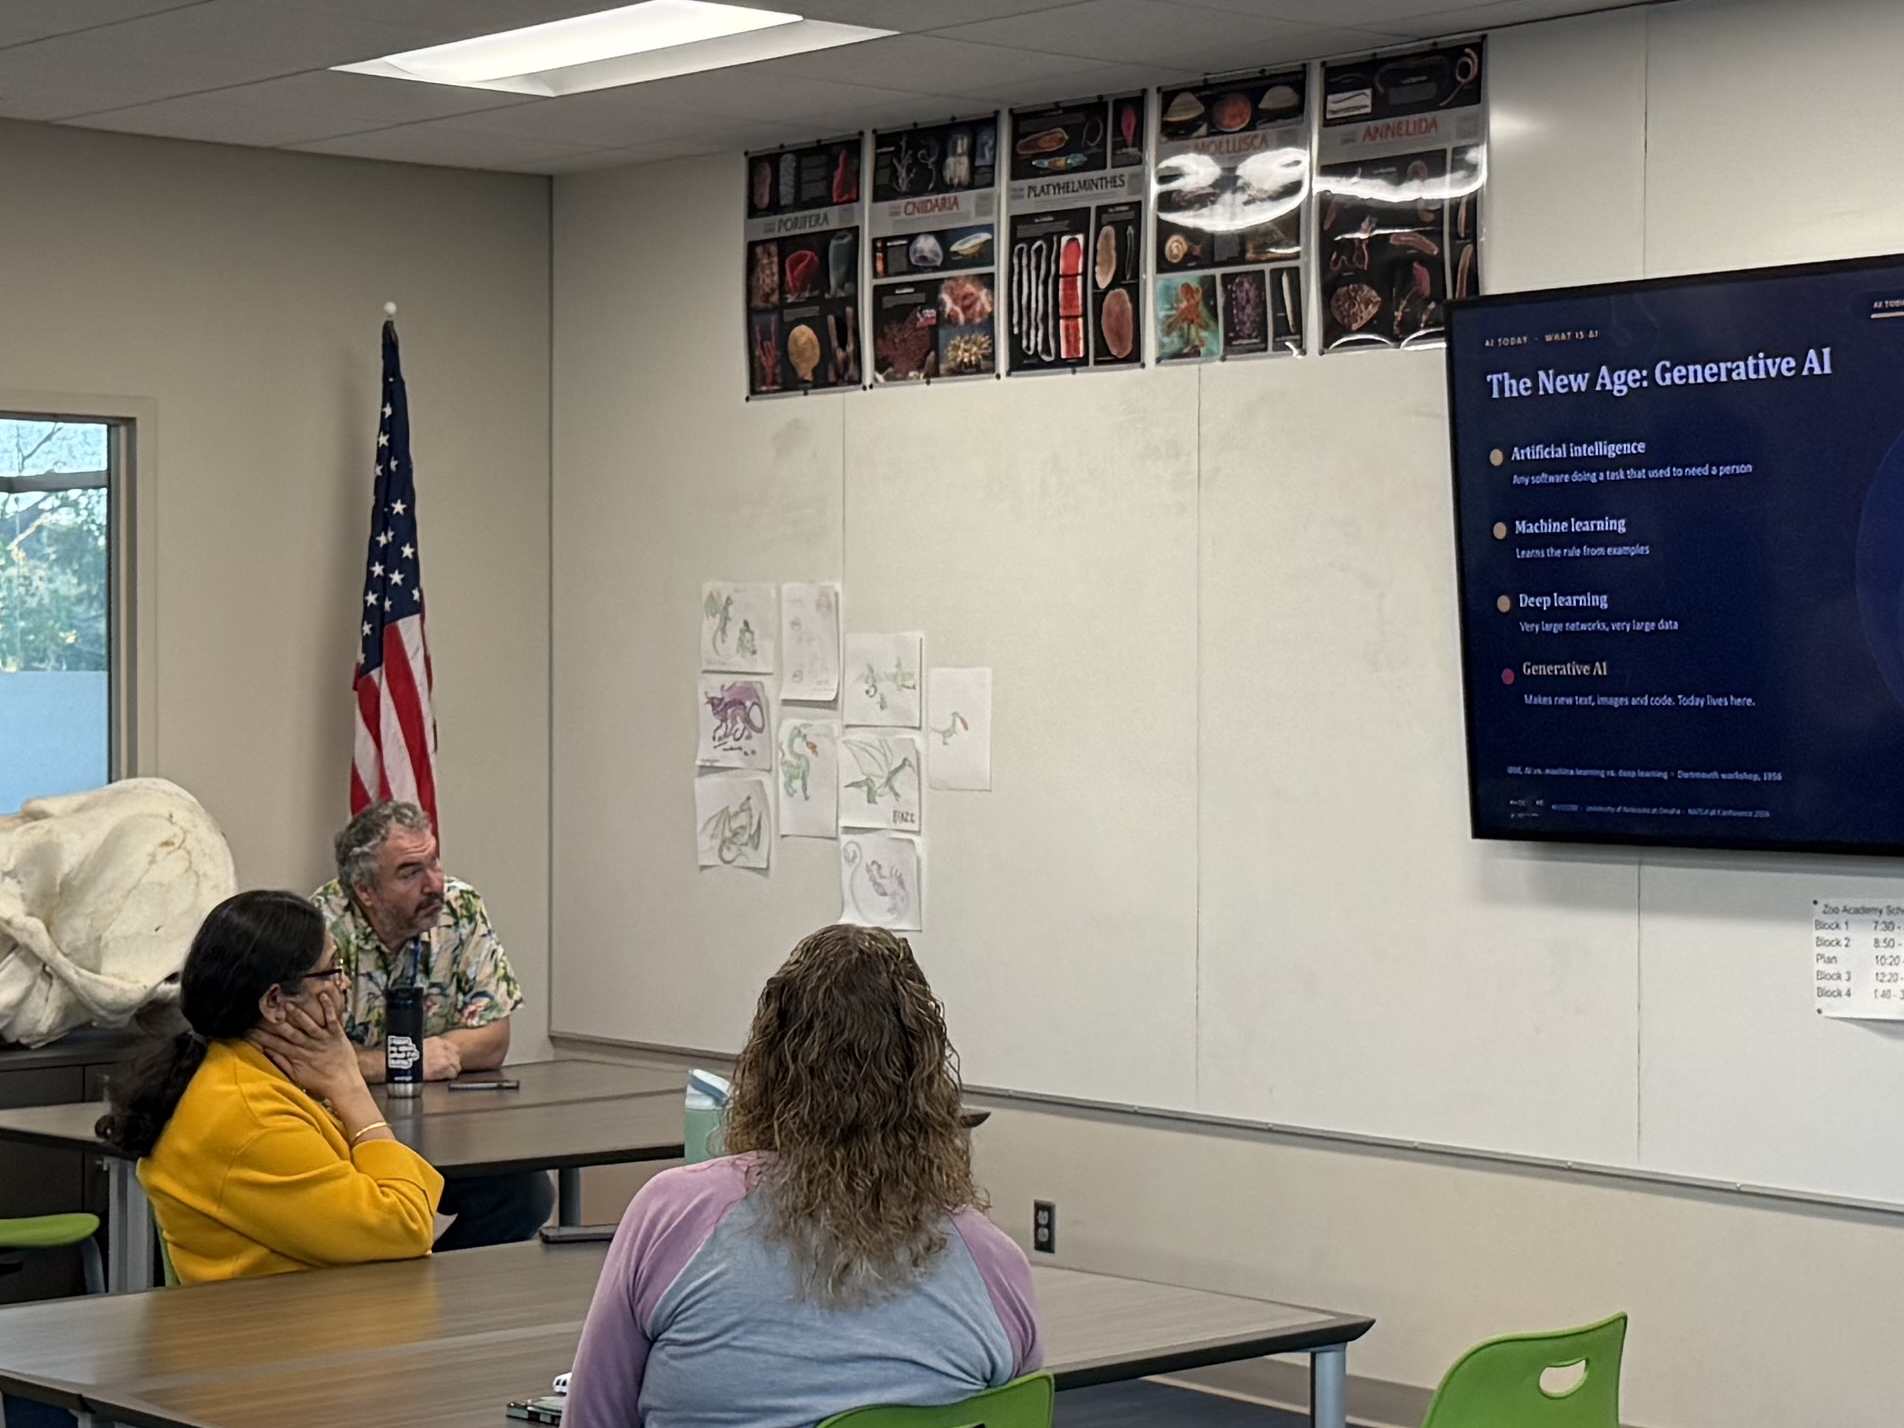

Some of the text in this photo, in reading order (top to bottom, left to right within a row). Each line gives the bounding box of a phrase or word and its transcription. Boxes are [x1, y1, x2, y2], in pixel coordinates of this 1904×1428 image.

[1362, 117, 1439, 143] ANNELIDA
[1027, 174, 1125, 199] PLATYHELMINTHES
[903, 195, 960, 215] CNIDARIA
[1487, 347, 1831, 399] The New Age: Generative AI
[1512, 440, 1645, 461] Artificial intelligence
[1516, 516, 1626, 534] Machine learning
[1520, 592, 1608, 611] Deep learning
[1523, 661, 1607, 676] Generative AI
[1815, 918, 1841, 931] Block
[1844, 919, 1849, 930] 1
[1873, 920, 1895, 932] 7:30
[1816, 936, 1841, 948] Block
[1844, 936, 1850, 948] 2
[1874, 937, 1895, 949] 8:50
[1816, 952, 1837, 965] Plan
[1875, 954, 1900, 967] 10:20
[1816, 969, 1841, 981] Block
[1846, 970, 1851, 982] 3
[1876, 971, 1898, 984] 12:20
[1817, 986, 1842, 999] Block
[1845, 987, 1851, 998] 4
[1874, 988, 1891, 1000] 1:40
